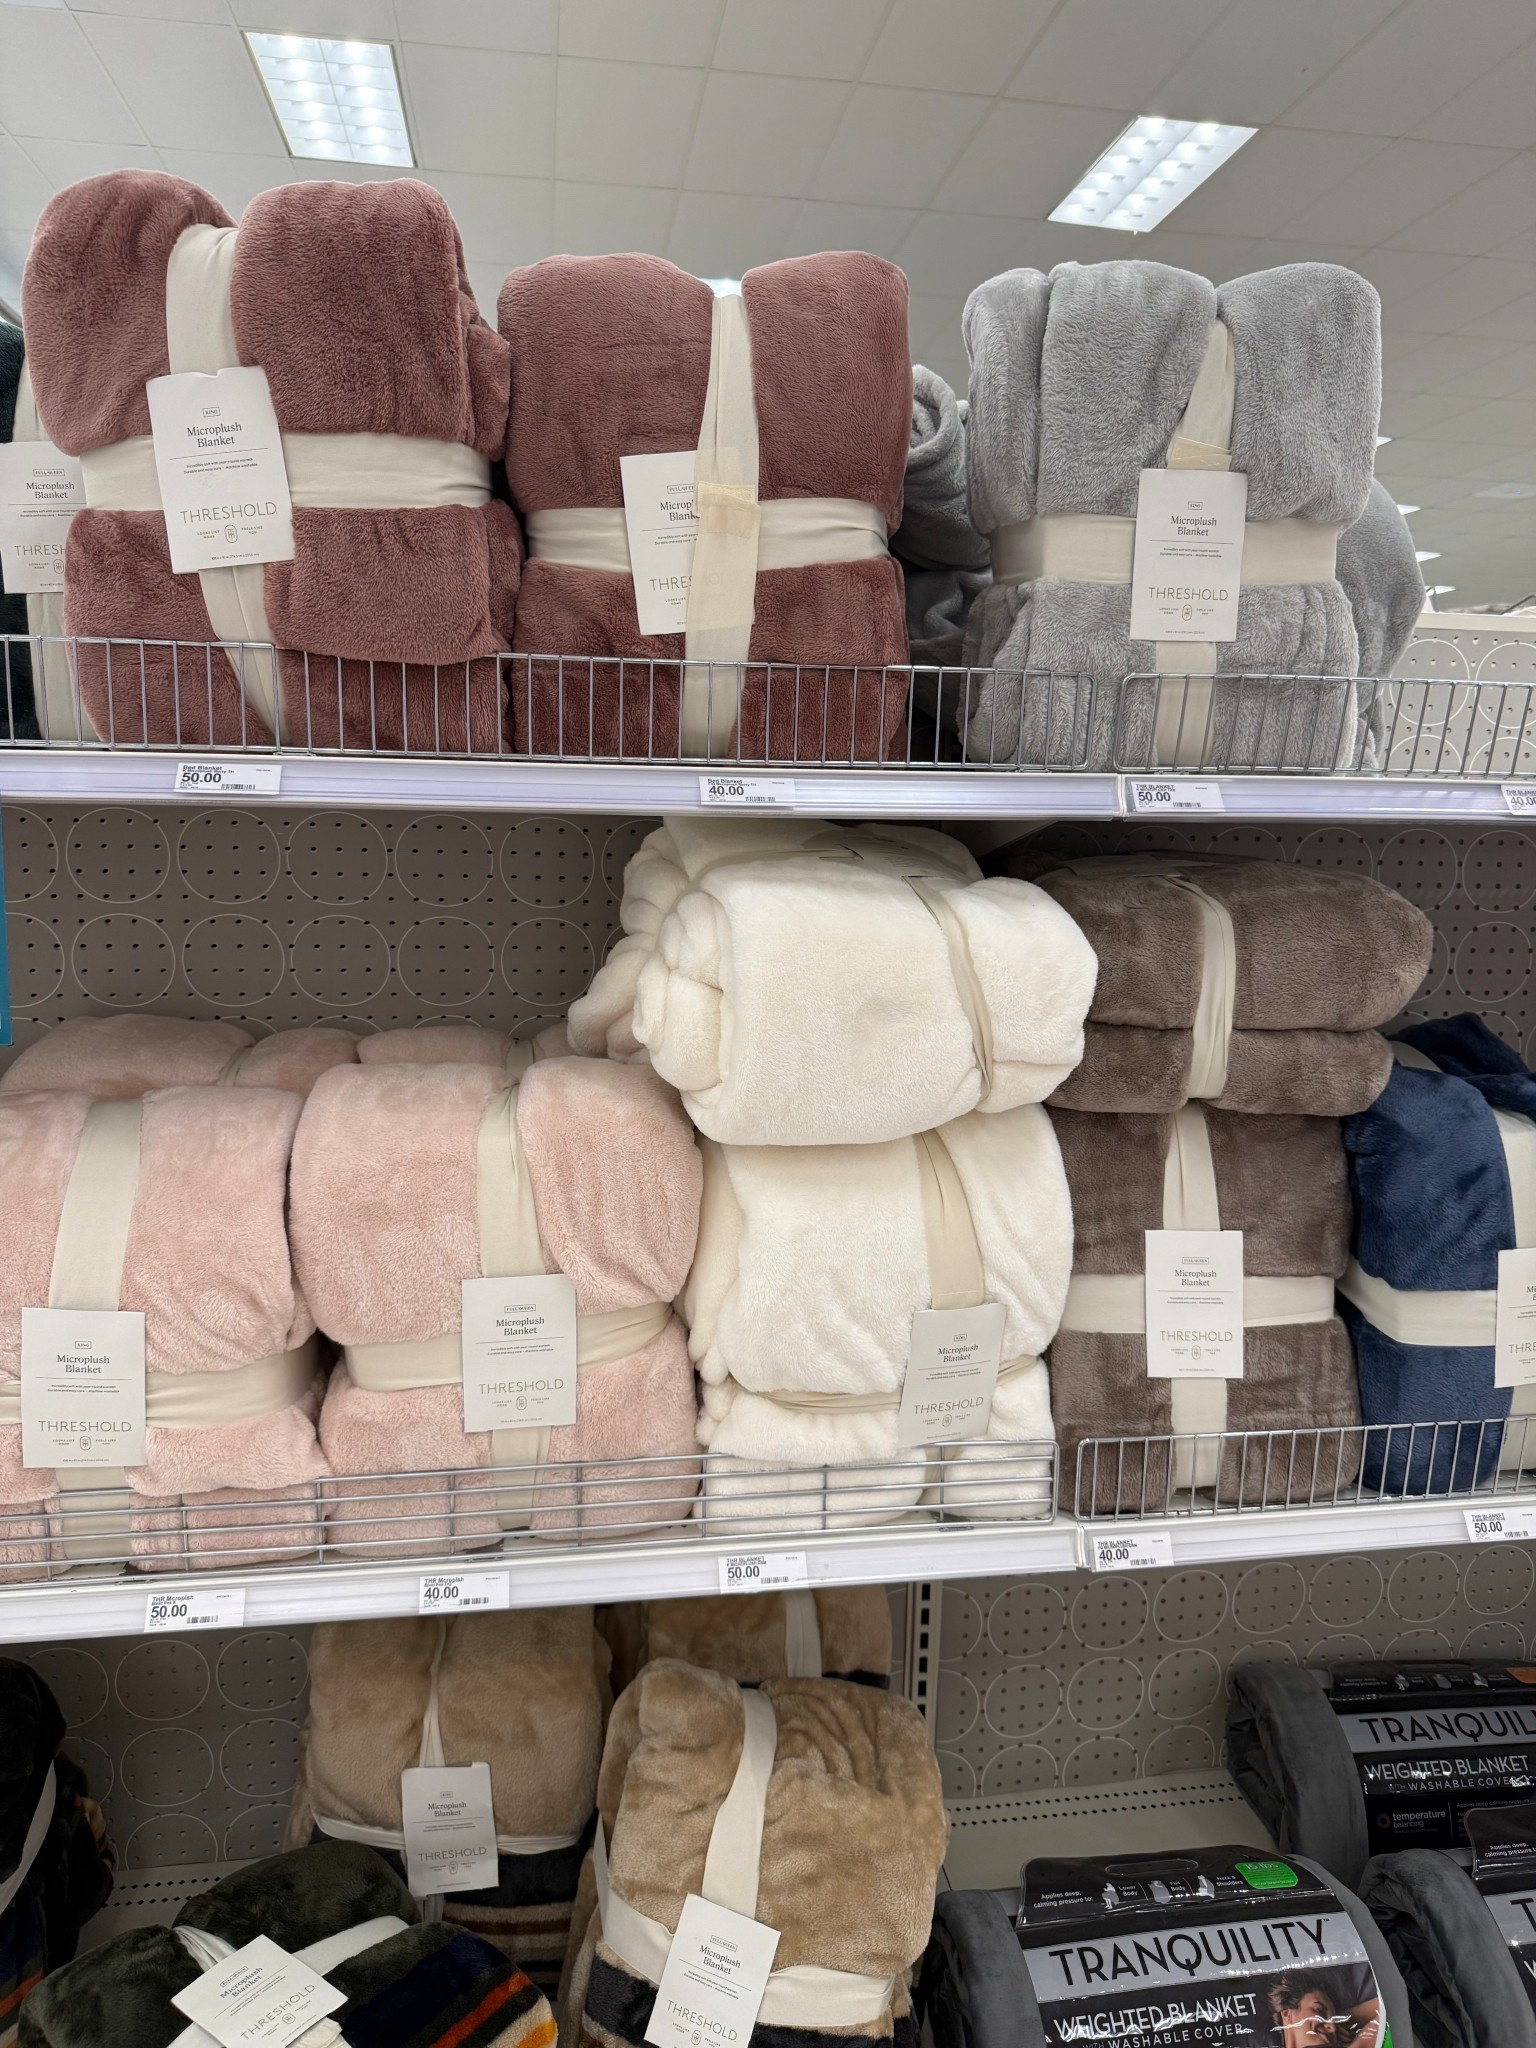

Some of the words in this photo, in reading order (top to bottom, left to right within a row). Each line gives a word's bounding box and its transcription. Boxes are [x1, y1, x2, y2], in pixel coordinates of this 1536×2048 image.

[186, 422, 242, 437] Microplush
[197, 436, 235, 448] Blanket
[26, 481, 75, 491] Microplush
[34, 491, 68, 499] Blanket
[180, 502, 277, 524] THRESHOLD
[669, 511, 700, 522] Blank
[1170, 516, 1217, 526] Microplush
[1177, 527, 1209, 537] Blanket
[1148, 587, 1228, 601] THRESHOLD
[181, 773, 221, 783] 50.00
[709, 786, 744, 796] 40.00
[1138, 792, 1171, 802] 50.00
[1175, 1270, 1217, 1279] Microplush
[1181, 1279, 1210, 1287] Blanket
[496, 1316, 545, 1327] Microplush
[504, 1327, 537, 1336] Blanket
[1160, 1331, 1233, 1342] THRESHOLD
[938, 1344, 979, 1355] Microplush
[57, 1354, 110, 1365] Microplush
[943, 1354, 971, 1363] Blanket
[65, 1365, 102, 1373] Blanket
[479, 1378, 564, 1394] THRESHOLD
[914, 1397, 984, 1415] THRESHOLD
[38, 1421, 131, 1432] THRESHOLD
[1475, 1522, 1502, 1533] 50.00
[1099, 1549, 1129, 1560] 40.00
[728, 1566, 760, 1578] 50.00
[424, 1586, 458, 1599] 40.00
[151, 1604, 188, 1618] 50.00
[1359, 1710, 1536, 1744] TRANQUIL
[1364, 1761, 1452, 1780] WEIGHTED
[1457, 1755, 1529, 1775] BLANKET
[1408, 1779, 1475, 1791] WASHABLE
[1478, 1776, 1519, 1786] COVE
[428, 1802, 467, 1810] Microplush
[1393, 1811, 1446, 1821] temperature
[418, 1847, 486, 1862] THRESHOLD
[1508, 1849, 1532, 1857] pressure
[1034, 1901, 1057, 1909] calming
[700, 1944, 741, 1968] Microplush
[703, 1956, 731, 1975] Blanket
[220, 1966, 263, 2000] Microplush
[231, 1975, 262, 1998] Blanket
[240, 1984, 316, 2040] THRESHOLD
[1054, 2006, 1163, 2040] WEIGHTED
[1167, 1993, 1256, 2024] BLANKET
[667, 2000, 738, 2041] THRESHOLD
[1108, 2030, 1190, 2048] WASHABLE
